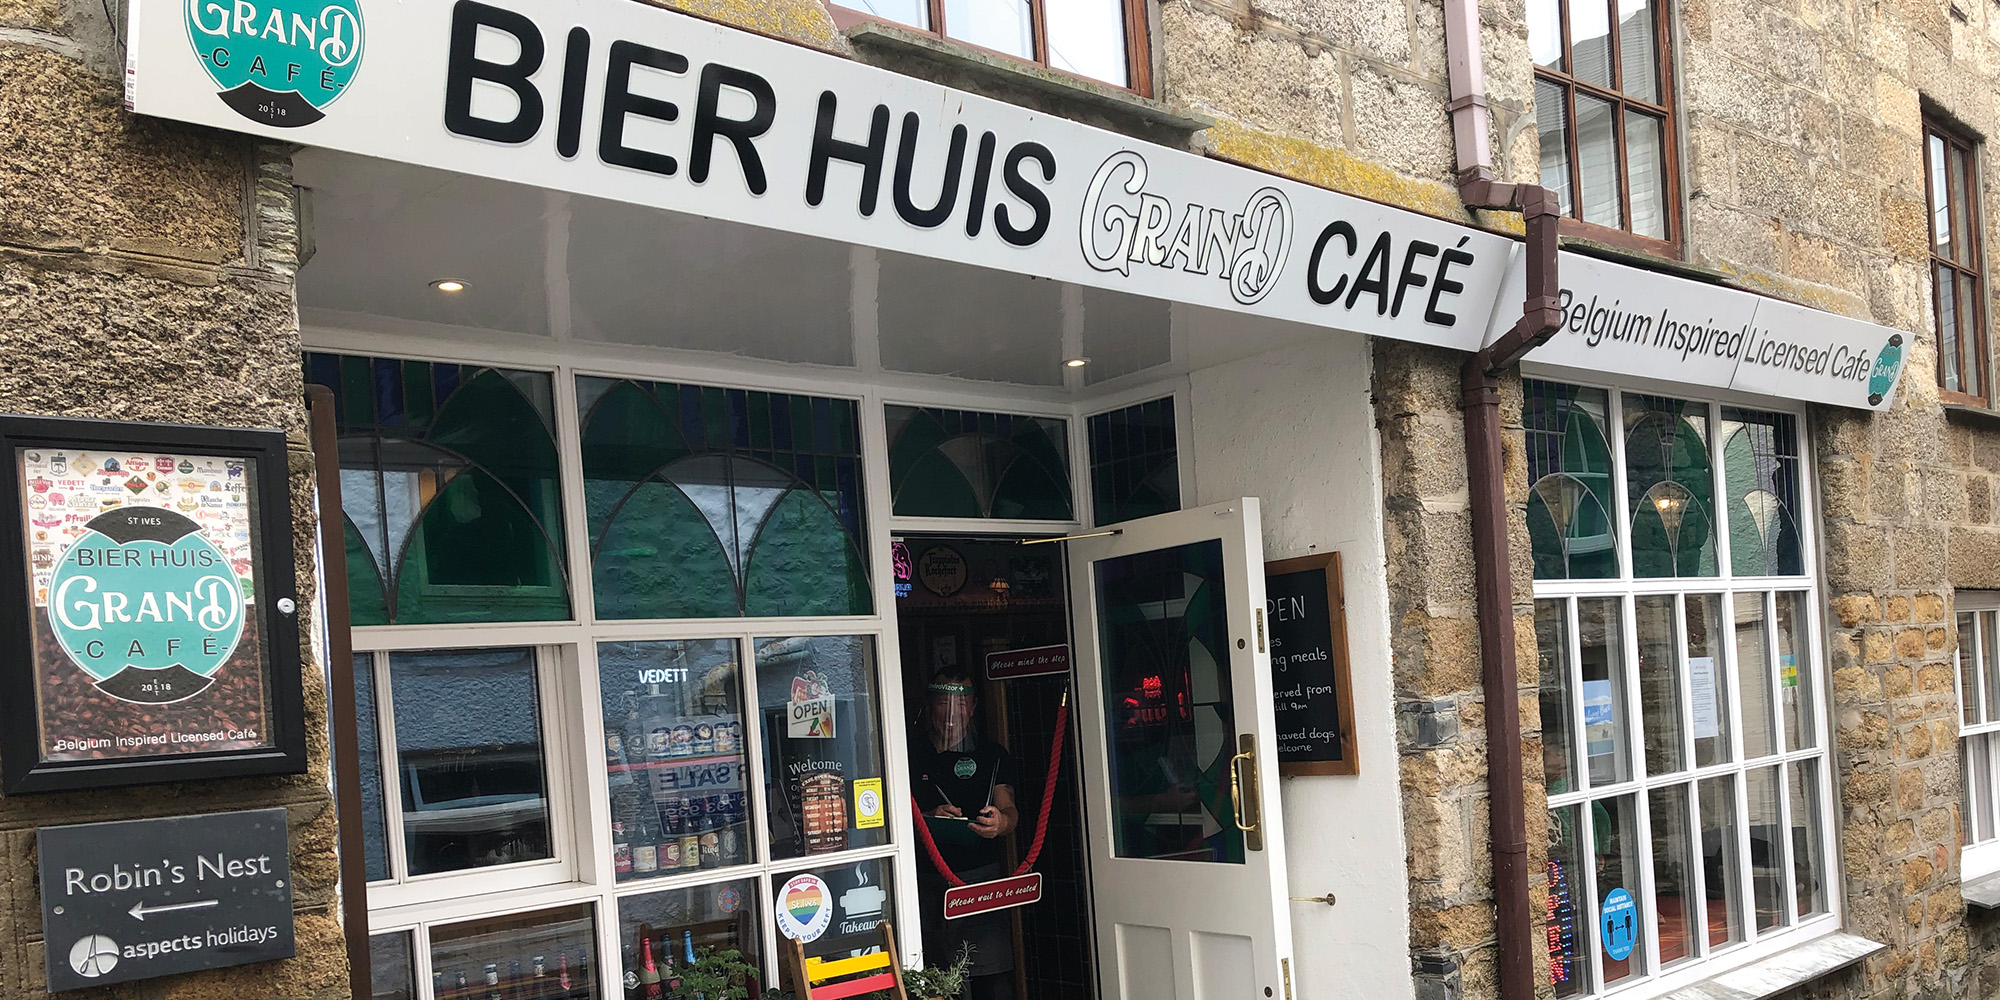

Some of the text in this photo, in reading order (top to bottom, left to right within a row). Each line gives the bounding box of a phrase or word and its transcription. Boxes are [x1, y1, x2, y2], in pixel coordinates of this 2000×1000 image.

[190, 0, 360, 67] GRAND
[444, 0, 1475, 327] BIER HUIS GRAND CAFÉ
[1558, 288, 1871, 381] Belgium Inspired Licensed Cafe
[127, 516, 162, 526] ST IVES
[55, 575, 238, 631] GRAND
[1267, 594, 1306, 622] PEN
[1270, 637, 1282, 648] es
[991, 653, 1066, 670] Please mind the step
[1271, 646, 1328, 672] ng meals
[638, 668, 689, 684] VEDETT
[141, 684, 152, 692] 20
[161, 683, 171, 691] 18
[1274, 683, 1332, 700] erved from
[793, 699, 828, 720] OPEN
[57, 738, 111, 751] Belgium
[116, 731, 167, 747] Inspired
[171, 727, 224, 742] Licensed
[1277, 727, 1336, 744] haved dogs
[1278, 742, 1313, 753] elcome
[789, 758, 842, 776] Welcome
[65, 852, 272, 896] Robin's Nest
[948, 882, 1038, 909] Please wait to be seated
[778, 907, 831, 941] KEEP TO YOUR LEFT
[839, 919, 889, 935] Takeaw
[123, 925, 278, 959] aspects holidays
